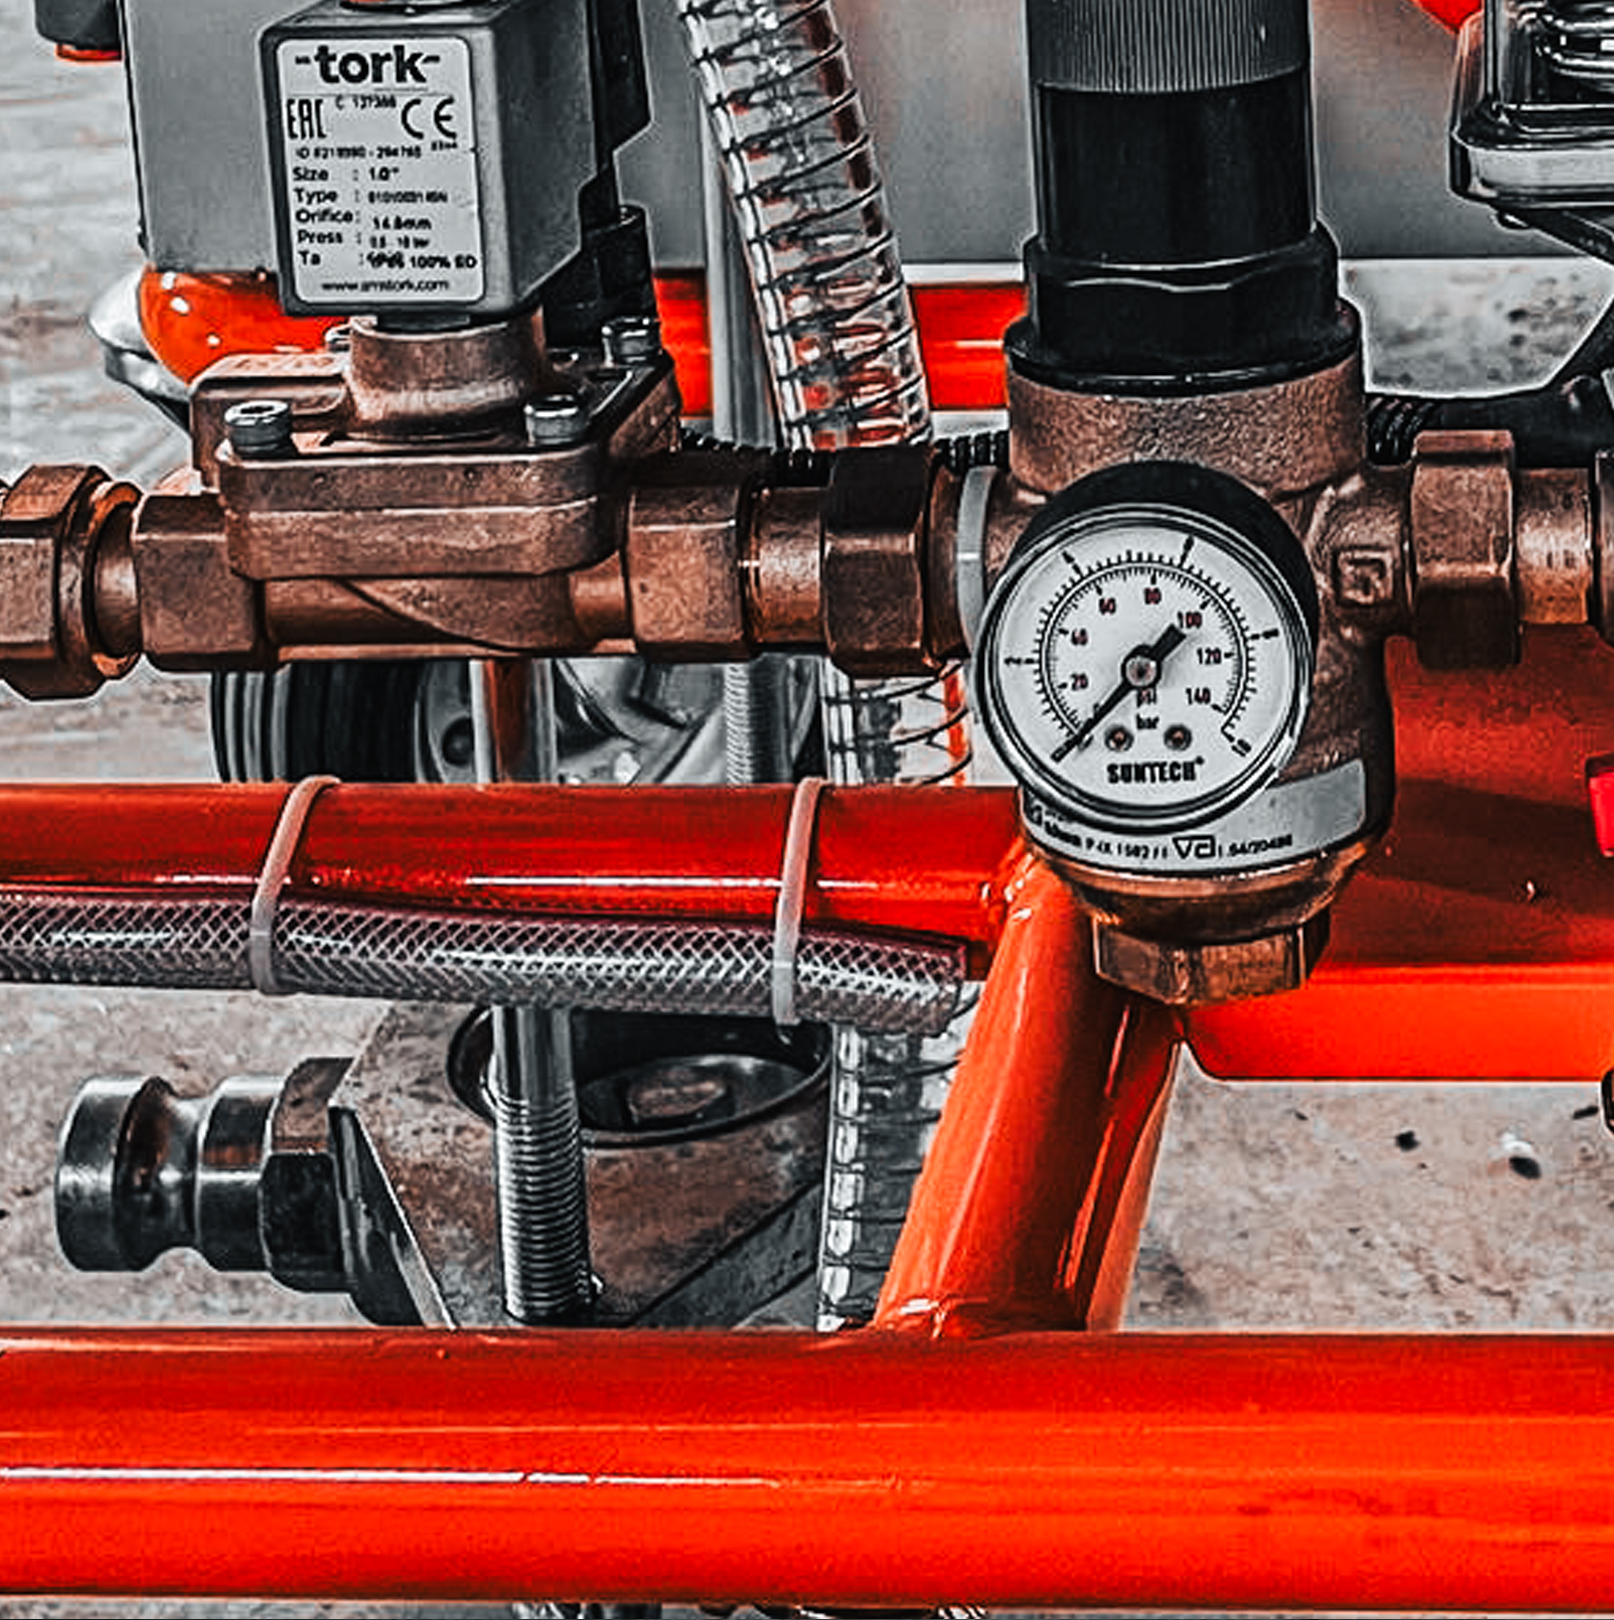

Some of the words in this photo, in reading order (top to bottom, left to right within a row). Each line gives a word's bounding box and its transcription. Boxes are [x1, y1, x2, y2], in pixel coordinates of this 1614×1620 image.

[286, 98, 328, 140] EAC
[400, 96, 458, 141] CE
[293, 166, 329, 181] Size
[294, 188, 338, 205] Type
[298, 230, 343, 244] Press
[299, 250, 321, 266] Ta
[1197, 647, 1222, 666] 120
[1069, 673, 1089, 691] 20
[1185, 687, 1212, 705] 140
[1135, 714, 1160, 730] bar
